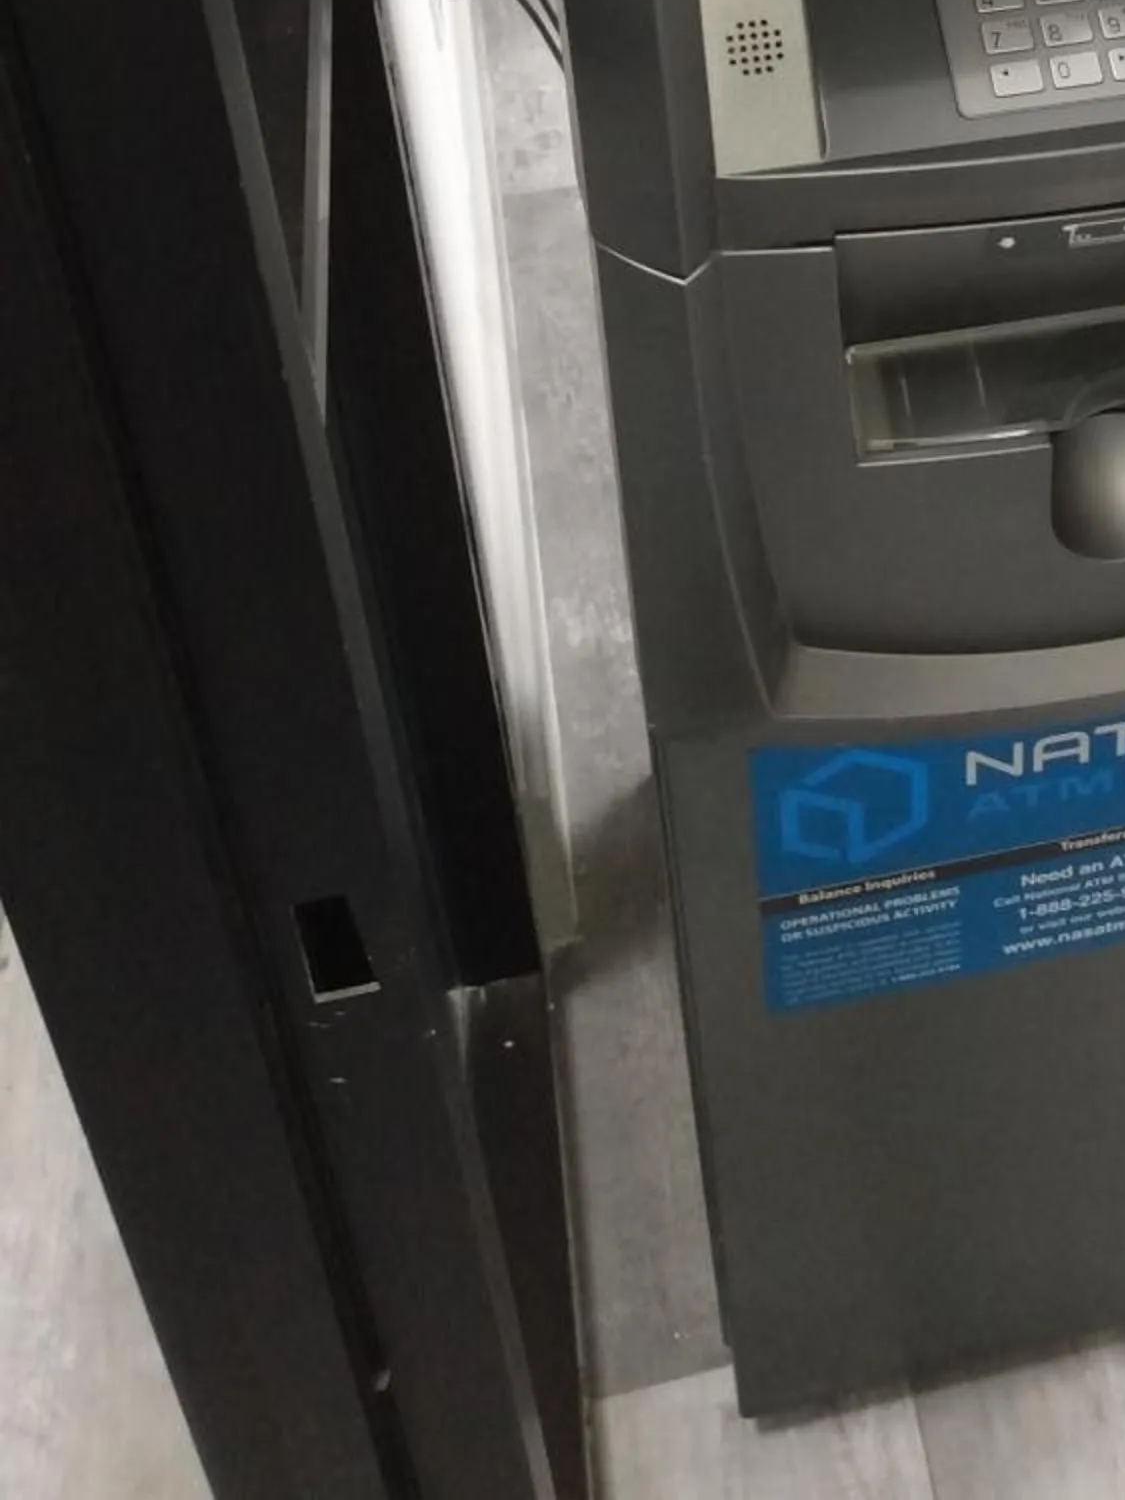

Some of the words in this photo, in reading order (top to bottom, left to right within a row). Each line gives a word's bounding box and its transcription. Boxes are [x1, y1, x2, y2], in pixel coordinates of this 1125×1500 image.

[1050, 24, 1062, 41] 8
[1107, 15, 1121, 33] 9
[990, 31, 1001, 49] 7
[968, 769, 1113, 821] ATM
[798, 884, 861, 905] Balance
[865, 869, 936, 891] Inquiries
[1020, 864, 1074, 888] Need
[1079, 861, 1104, 875] an
[1084, 874, 1114, 889] ATM
[780, 901, 880, 931] OPERATIONAL
[884, 885, 961, 909] PROBLEMS
[780, 931, 804, 944] OR
[806, 912, 891, 939] SUSPICIOUS
[893, 898, 958, 920] ACTIVITY
